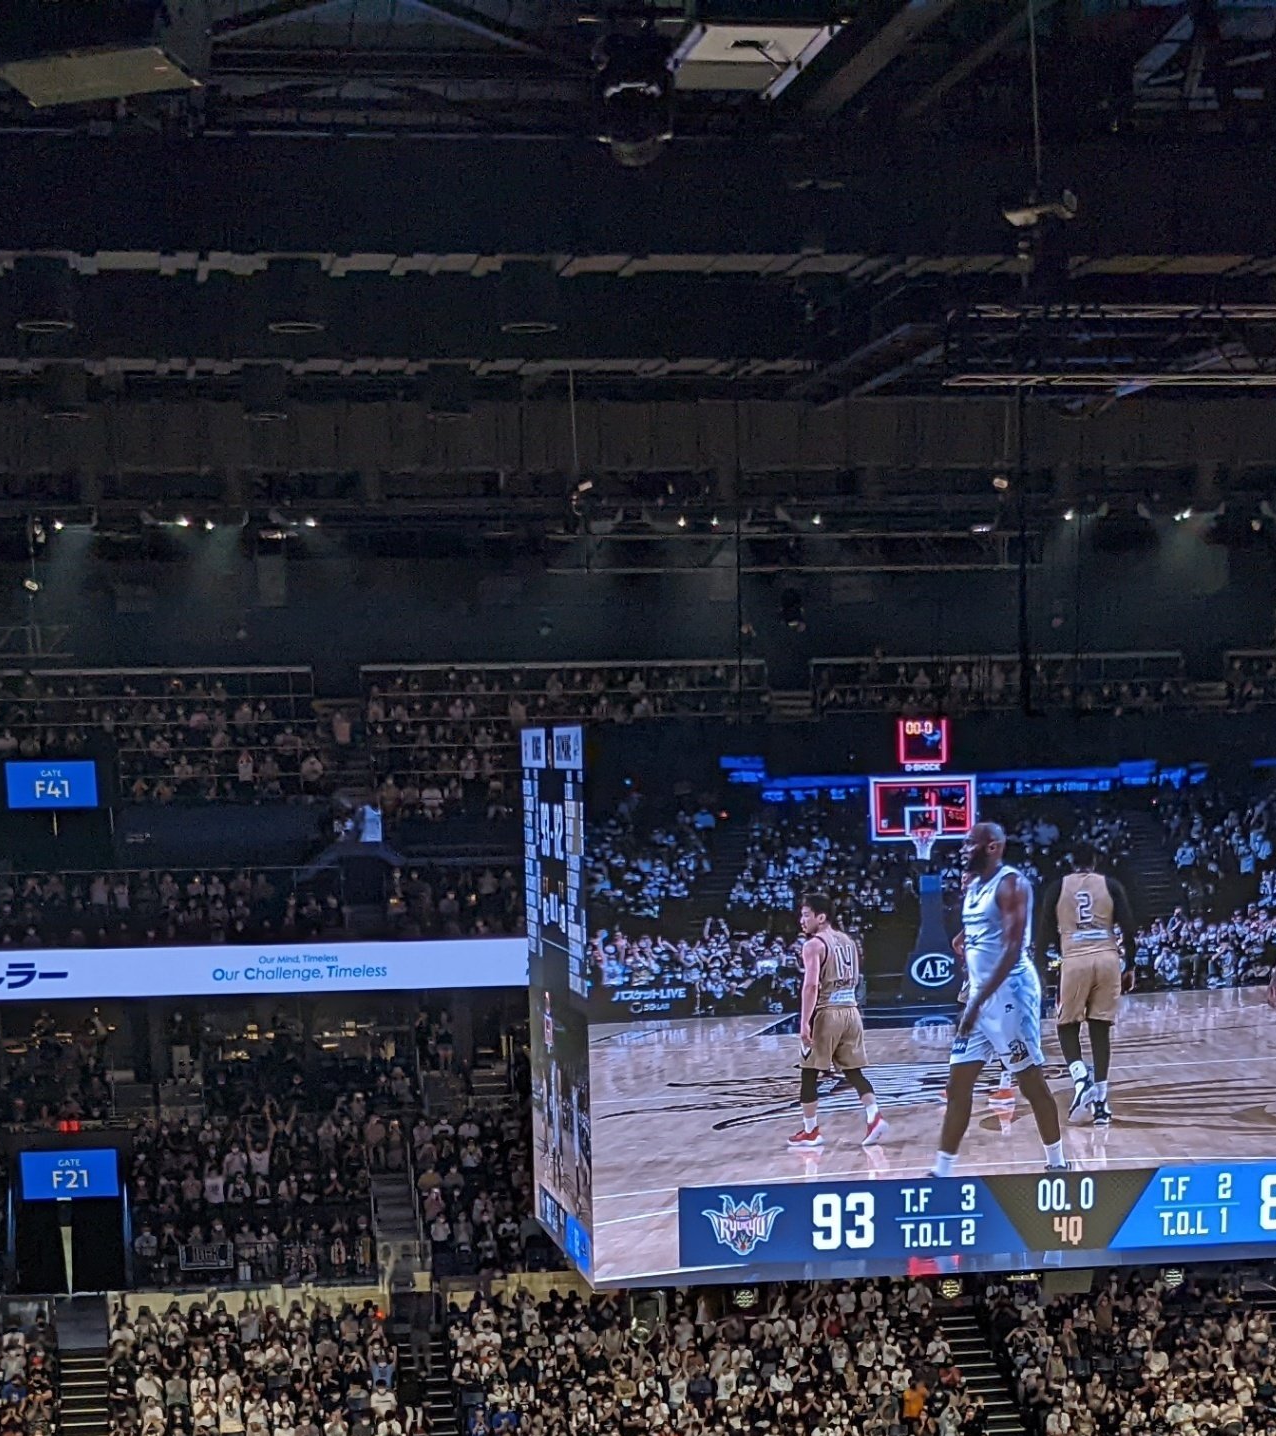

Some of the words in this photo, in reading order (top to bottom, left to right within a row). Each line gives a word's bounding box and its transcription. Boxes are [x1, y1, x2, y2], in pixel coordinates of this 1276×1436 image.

[40, 769, 61, 777] GATE
[35, 780, 69, 799] F41
[259, 956, 274, 965] Our
[303, 954, 338, 963] Timeless
[212, 968, 240, 981] Our
[244, 966, 323, 982] Challenge,
[327, 964, 387, 978] Timeless
[922, 960, 950, 979] AE
[58, 1158, 81, 1168] GATE
[51, 1170, 89, 1189] F21
[1161, 1176, 1190, 1202] T.F
[1218, 1172, 1232, 1200] 2
[901, 1187, 932, 1213] T.F
[961, 1184, 976, 1211] 3
[812, 1191, 875, 1250] 93
[1159, 1209, 1209, 1237] T.O.L
[1220, 1207, 1228, 1234] 1
[901, 1222, 952, 1248] T.O.L
[961, 1219, 975, 1246] 2
[1053, 1216, 1083, 1246] 4Q
